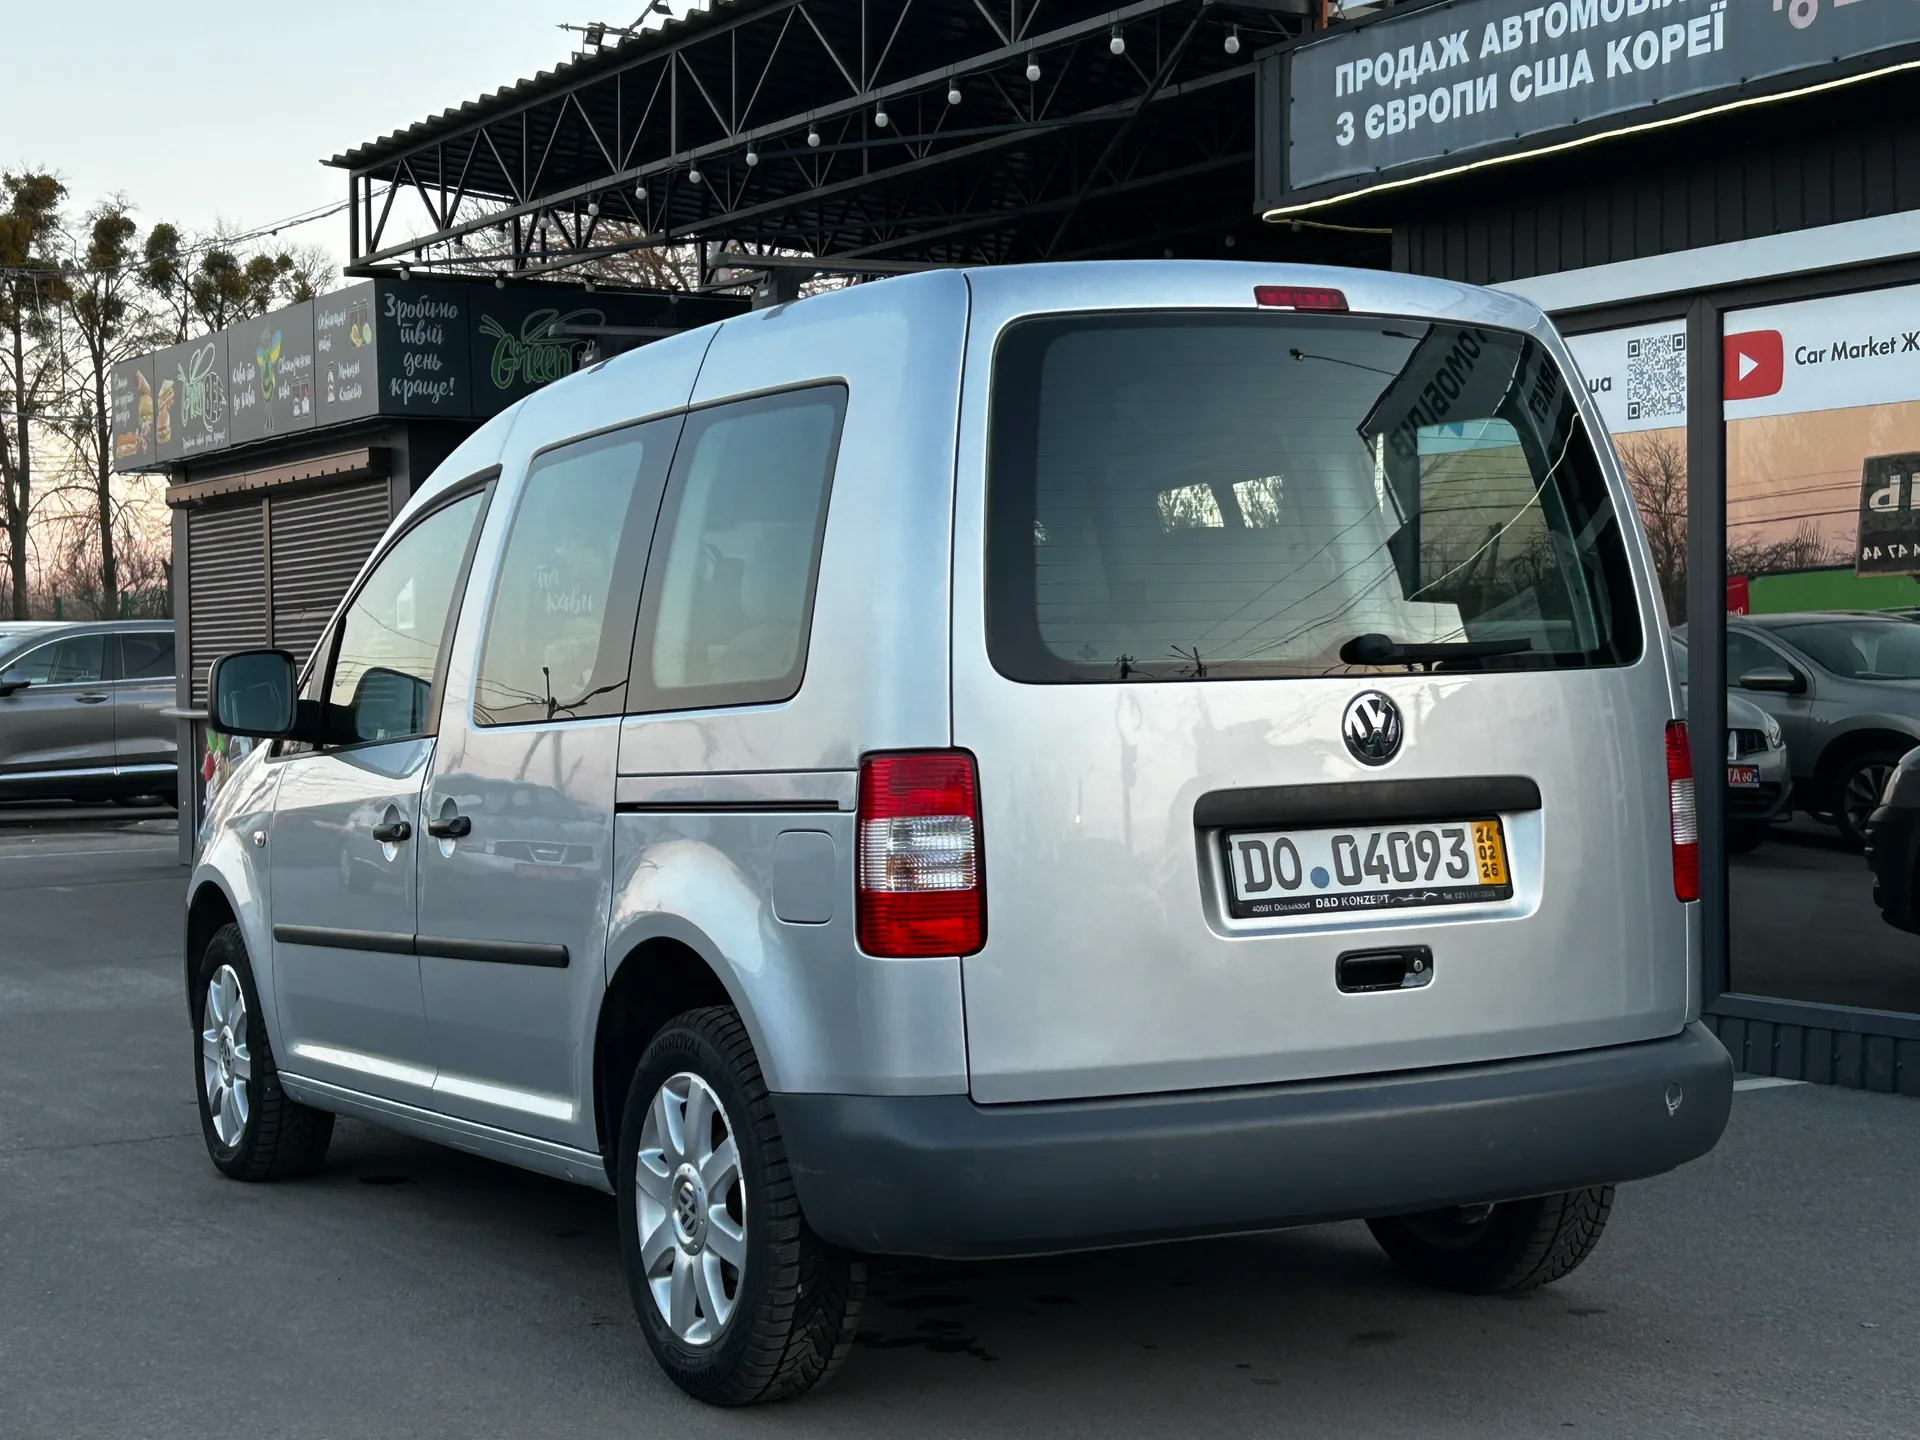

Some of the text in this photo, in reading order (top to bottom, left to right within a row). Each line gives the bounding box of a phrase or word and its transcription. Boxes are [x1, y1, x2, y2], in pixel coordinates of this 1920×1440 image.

[1335, 0, 1686, 97] ПРОДАЖ АВТОМО
[1335, 111, 1355, 146] З
[1364, 73, 1498, 140] ЄВРОПИ
[1509, 48, 1594, 103] США
[1606, 0, 1727, 79] КОРЕЇ
[383, 292, 458, 326] Зробимо
[400, 319, 444, 345] твій
[403, 352, 444, 376] день
[1794, 345, 1827, 366] Car
[1830, 336, 1897, 362] Market
[389, 377, 455, 405] краще!
[1238, 828, 1470, 893] DO 04093
[1315, 897, 1339, 909] D&D
[1341, 894, 1390, 907] KONZEPT
[650, 1033, 702, 1058] UNIROYAL
